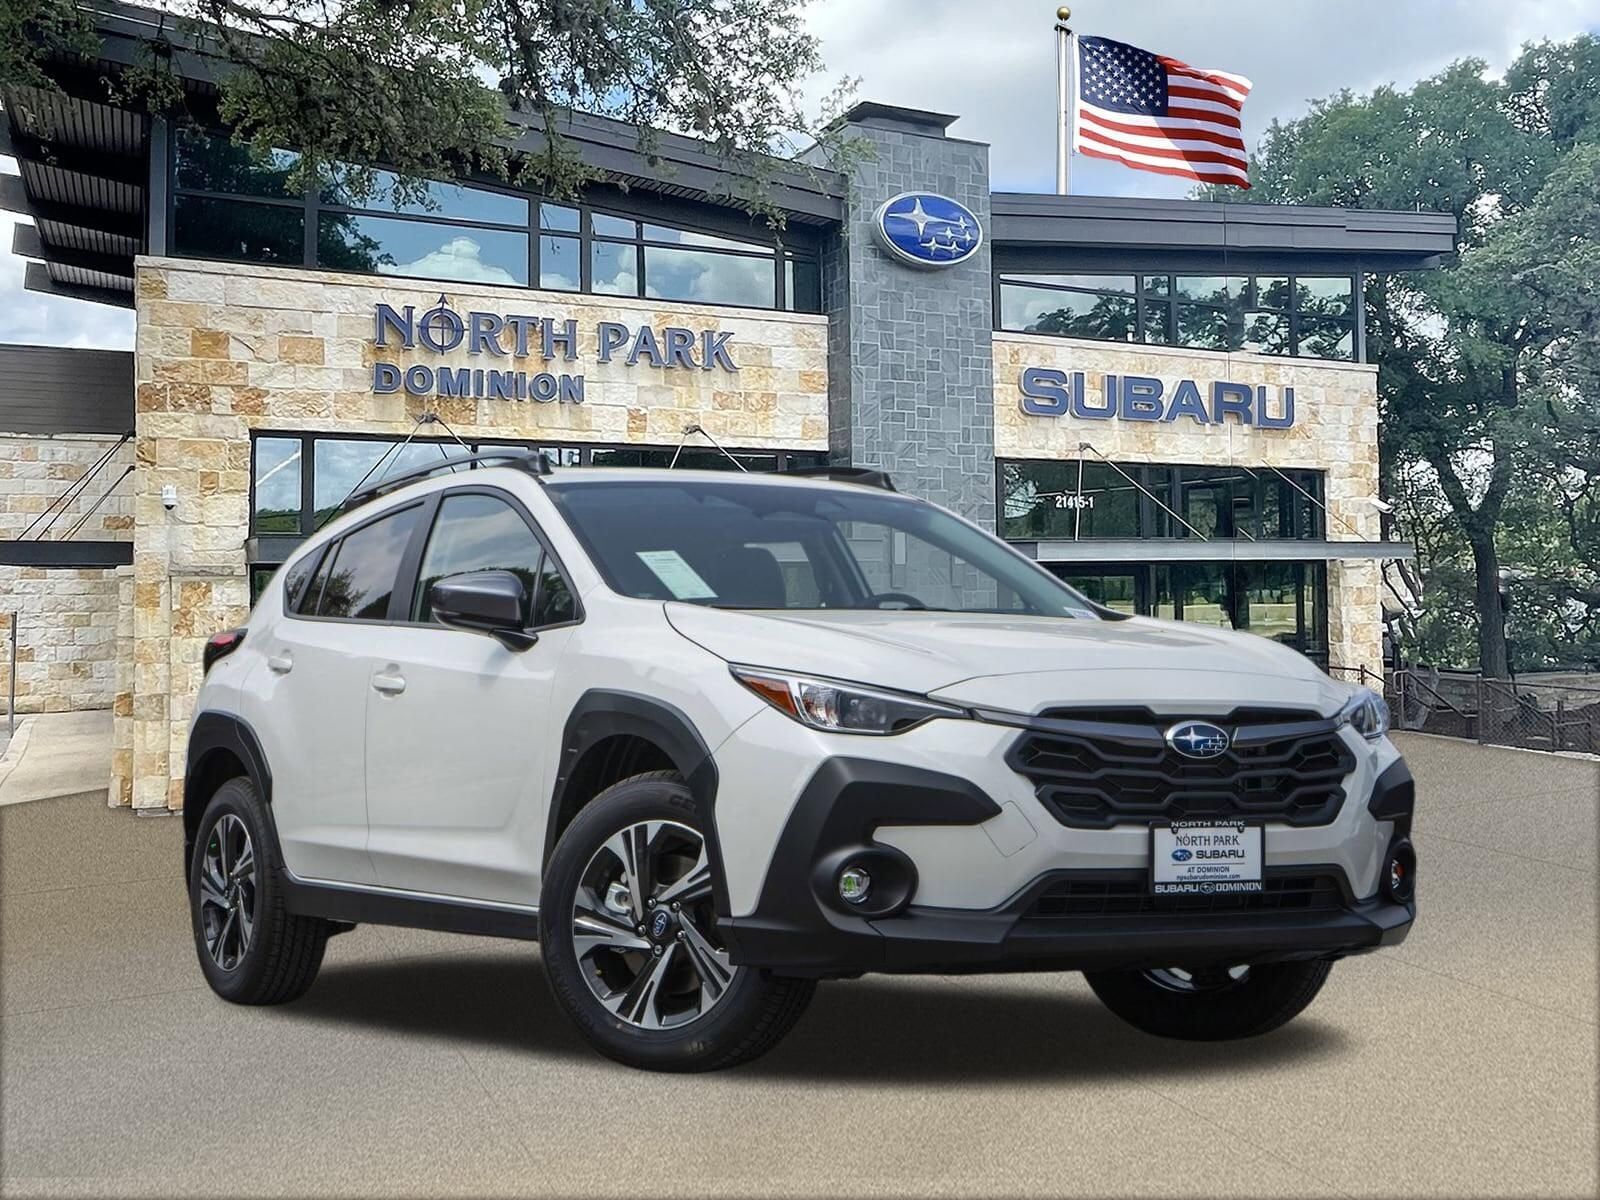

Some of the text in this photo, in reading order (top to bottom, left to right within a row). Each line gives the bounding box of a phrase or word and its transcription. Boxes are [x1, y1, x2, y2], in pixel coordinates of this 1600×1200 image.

[373, 300, 741, 373] NORTH PARK
[373, 362, 585, 404] DOMINION
[1019, 367, 1296, 430] SUBARU
[1176, 835, 1240, 847] NORTH PARK
[1196, 850, 1245, 859] SUBARU
[1155, 882, 1262, 893] SUBARU DOMINION
